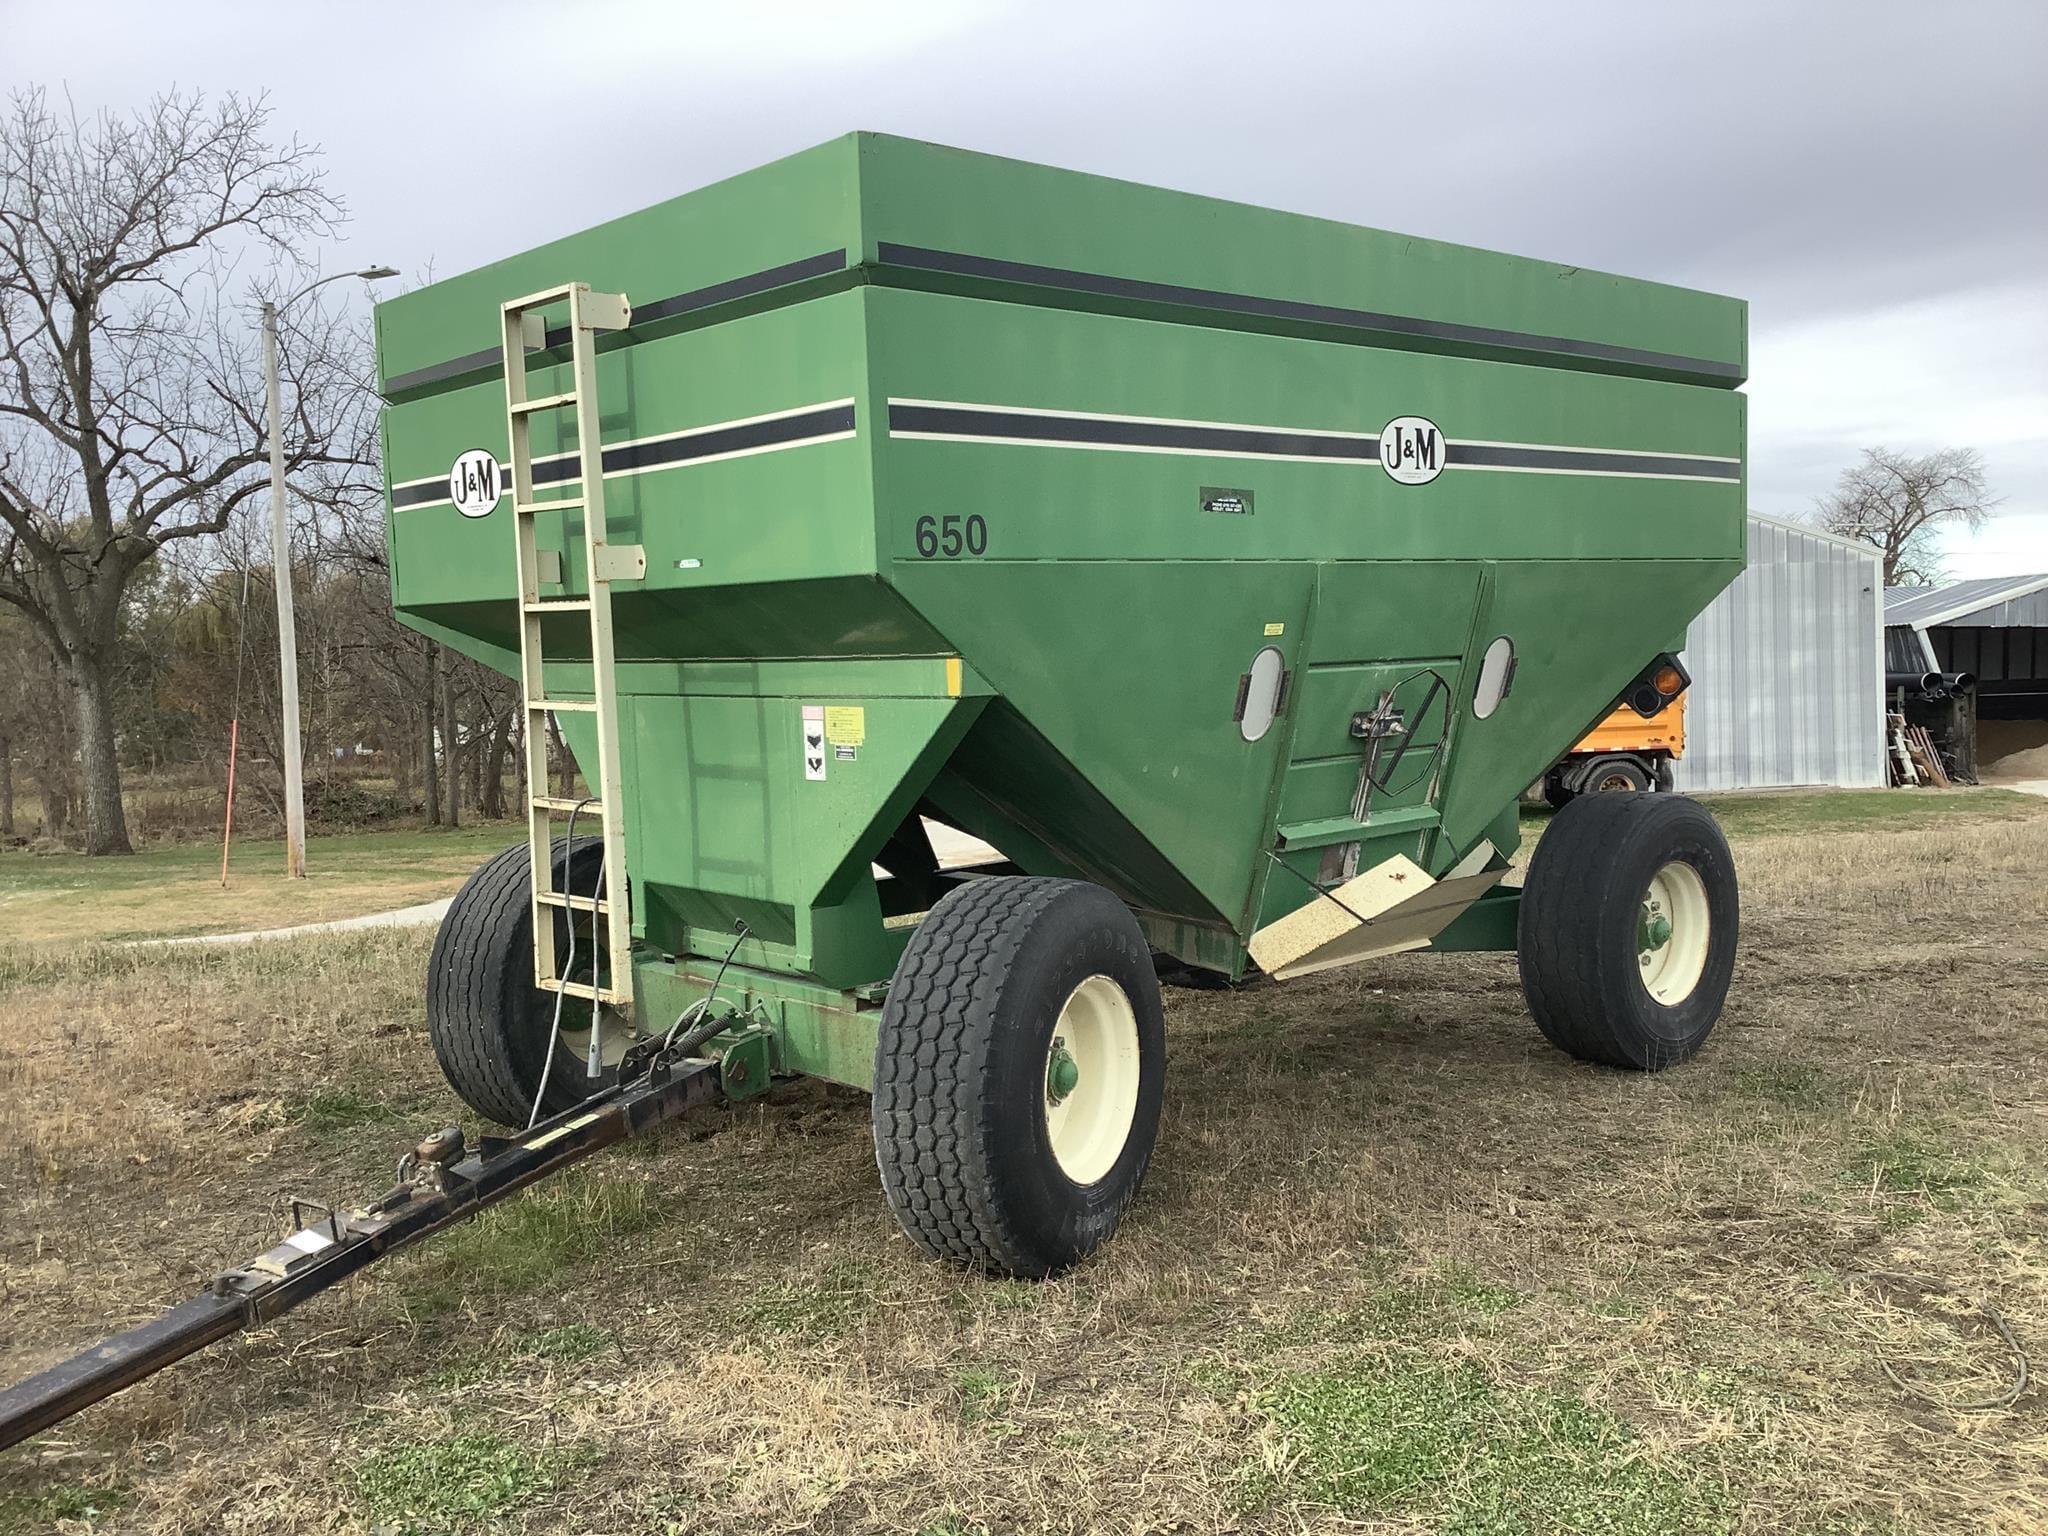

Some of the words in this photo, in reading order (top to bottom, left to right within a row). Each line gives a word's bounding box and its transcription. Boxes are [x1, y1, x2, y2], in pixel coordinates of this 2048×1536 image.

[1385, 427, 1437, 471] J&M
[454, 458, 496, 504] J&M
[915, 514, 988, 558] 650
